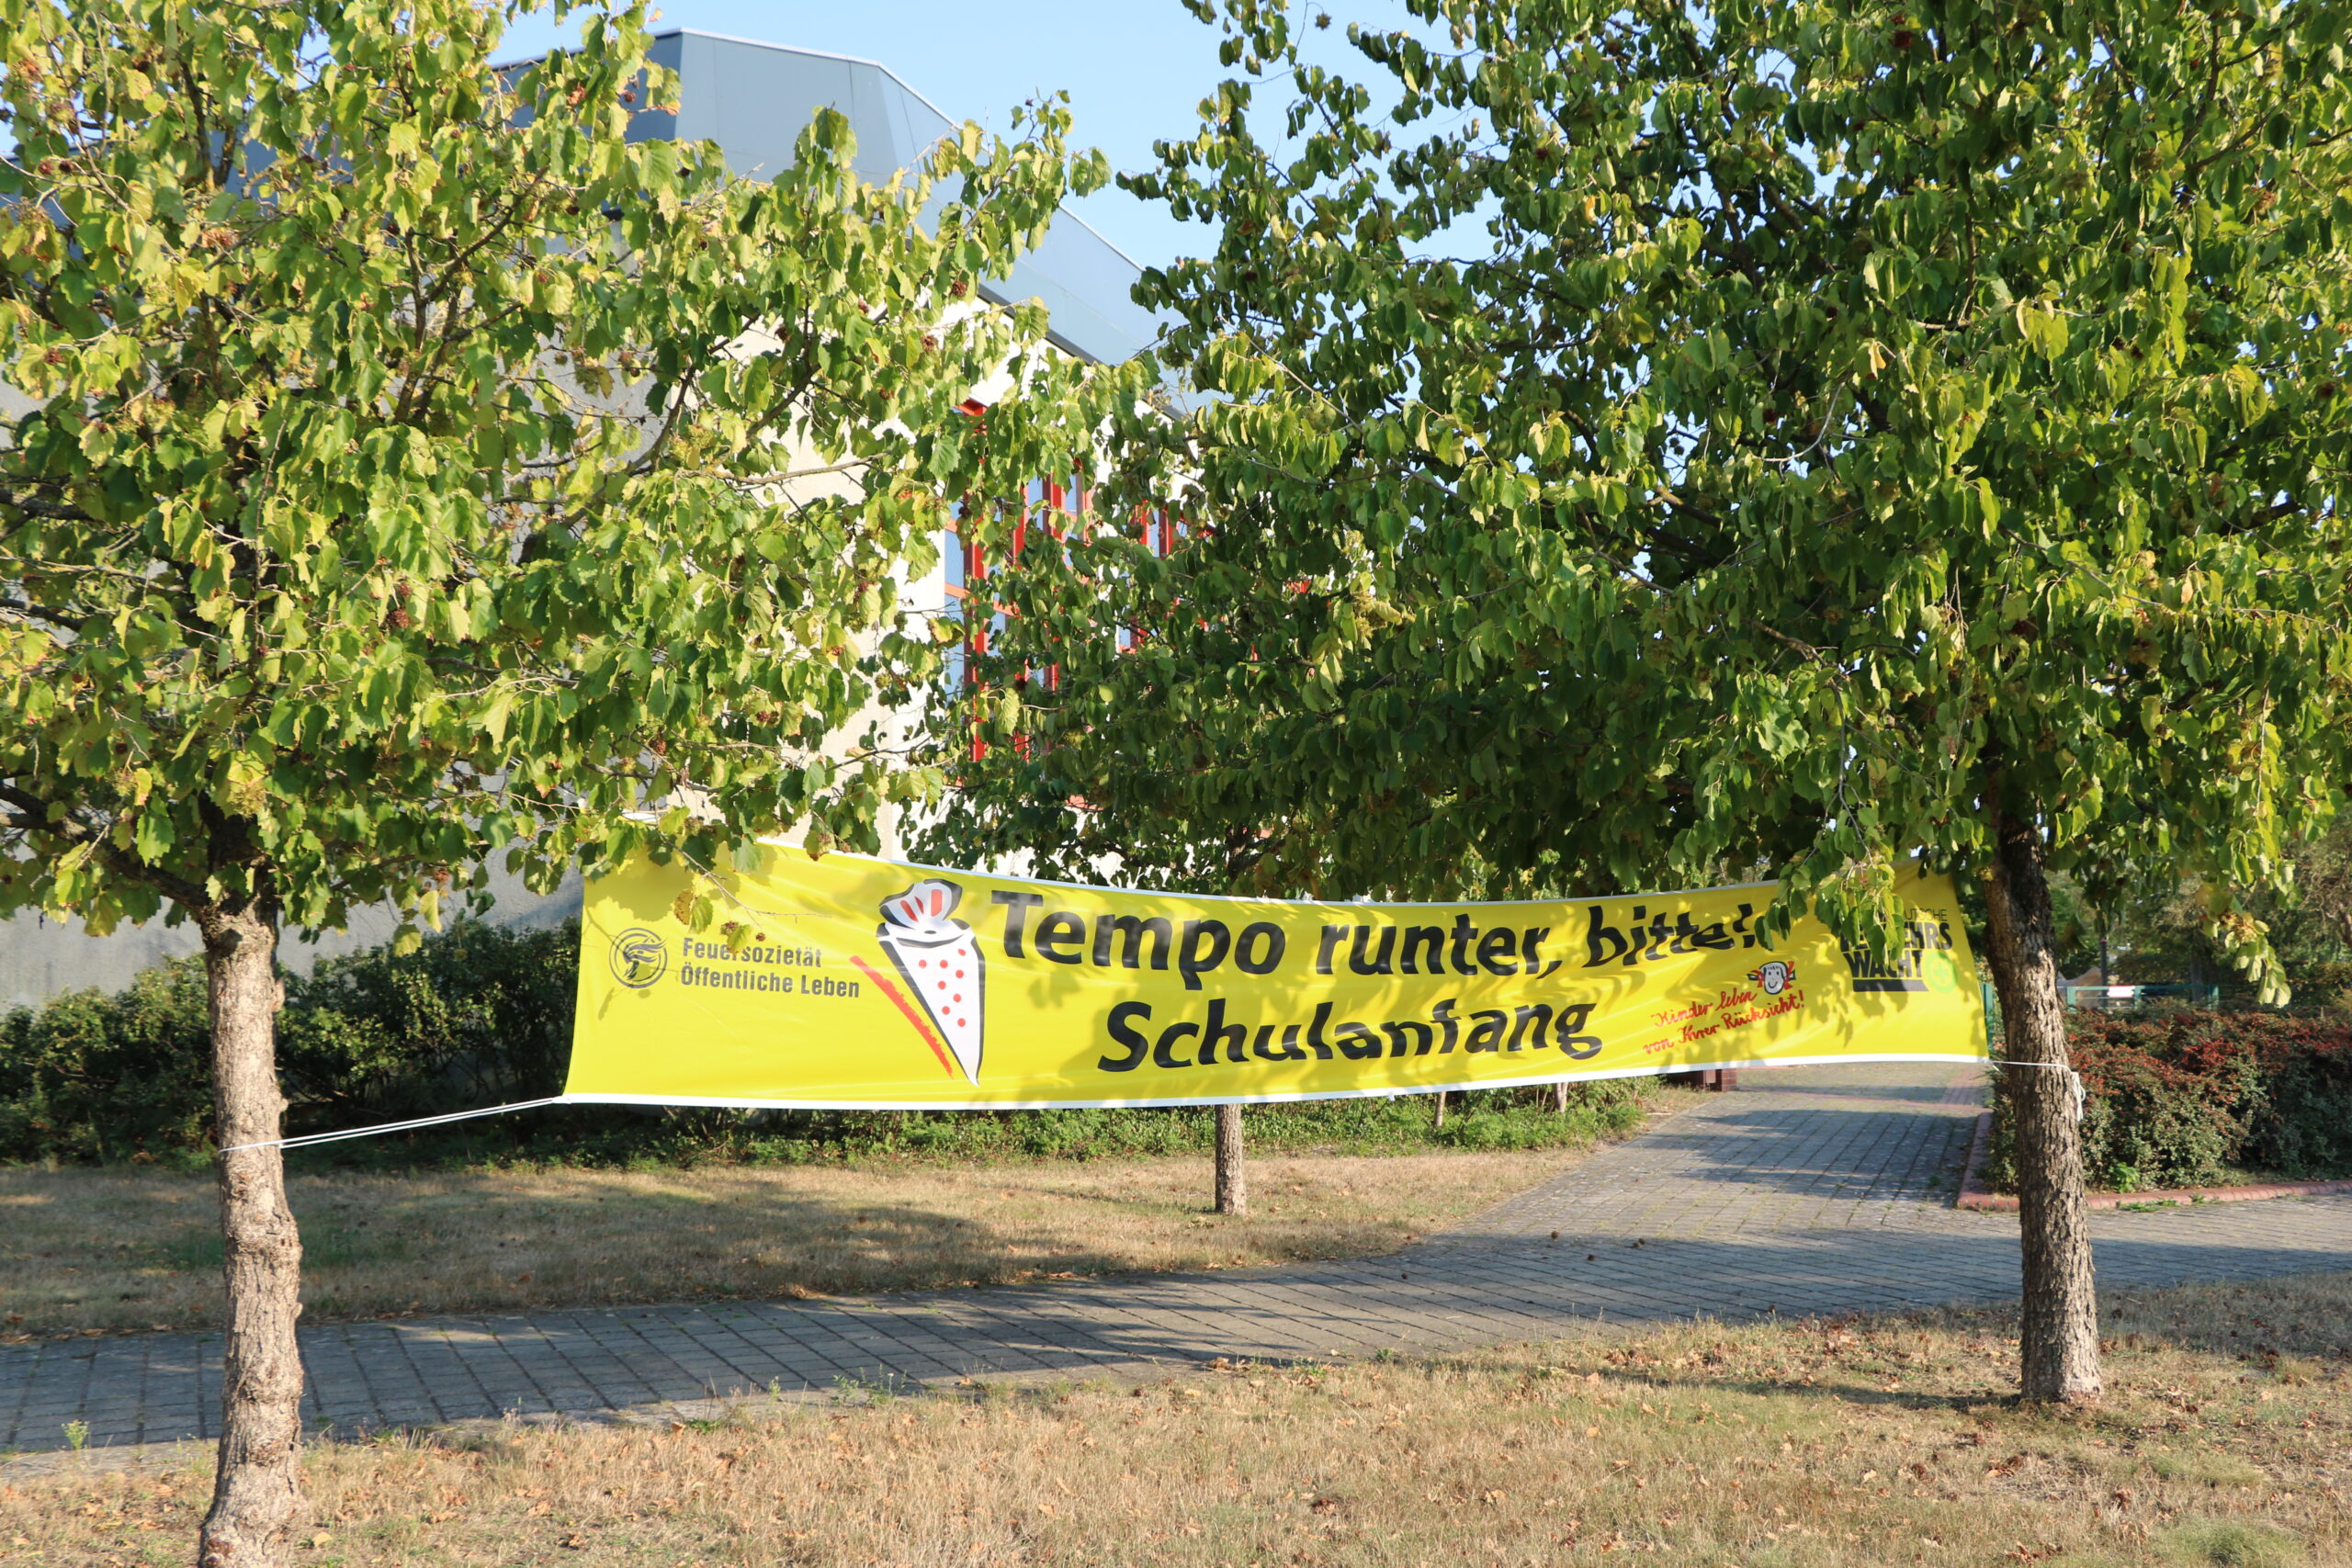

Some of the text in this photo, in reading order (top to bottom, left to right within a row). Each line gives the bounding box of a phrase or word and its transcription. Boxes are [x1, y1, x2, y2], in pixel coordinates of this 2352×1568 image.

[991, 889, 1756, 990] Tempo runter, bitte!
[681, 962, 860, 998] Öffentliche Leben
[1651, 987, 1758, 1027] Kinder leben
[1097, 998, 1602, 1072] Schulanfang
[1643, 1038, 1674, 1055] von
[1721, 990, 1804, 1029] Rücksicht!
